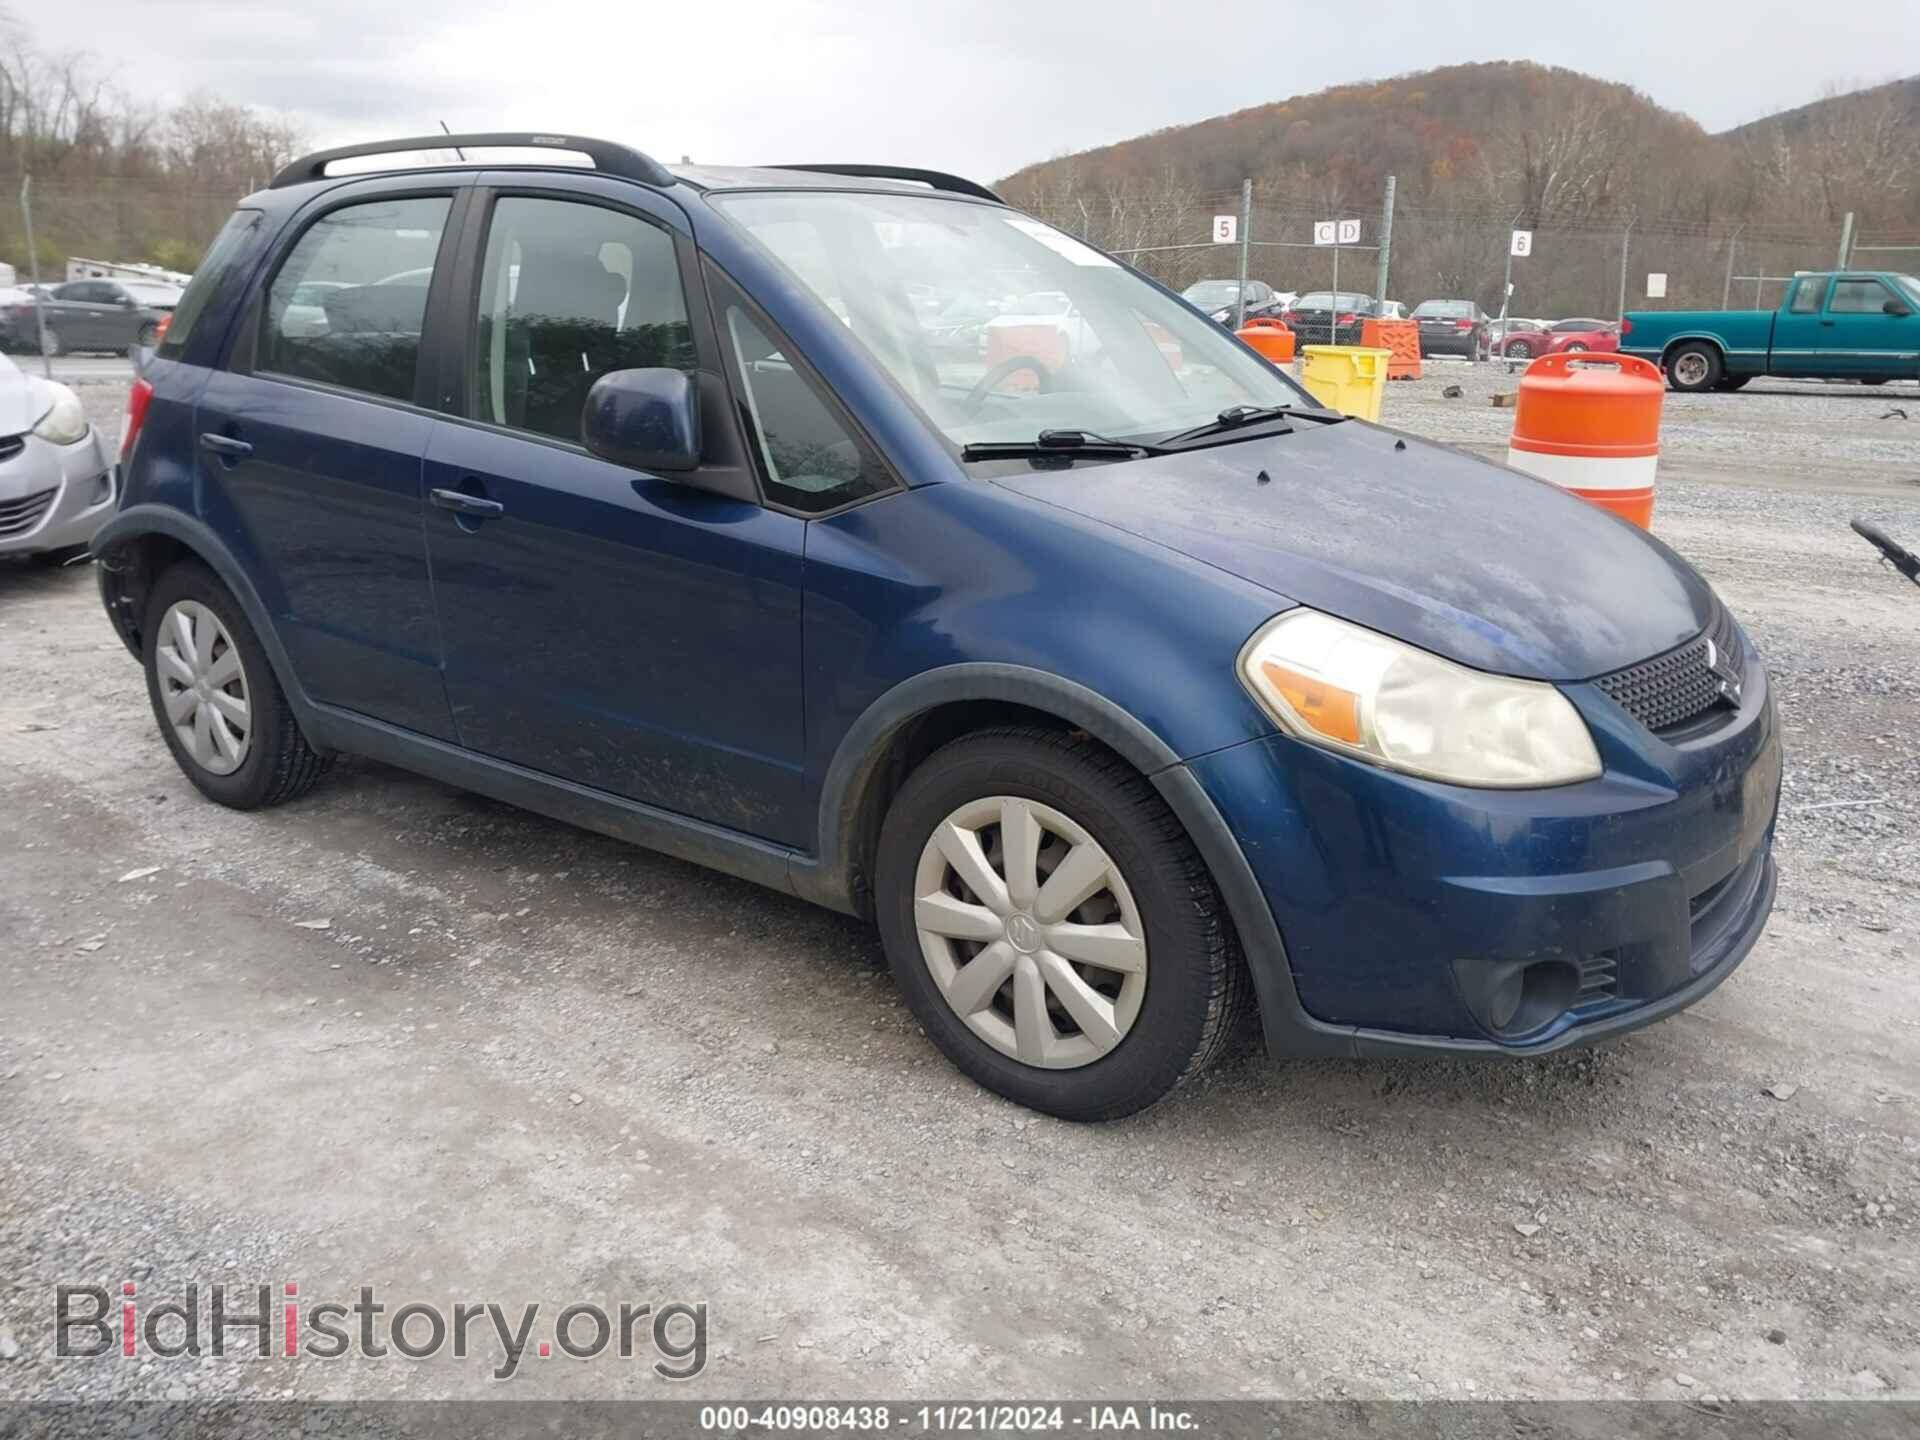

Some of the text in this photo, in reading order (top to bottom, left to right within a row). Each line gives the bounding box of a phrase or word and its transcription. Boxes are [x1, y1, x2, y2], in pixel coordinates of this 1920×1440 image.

[1219, 220, 1230, 238] 5
[1319, 225, 1331, 241] C
[1343, 224, 1356, 240] D
[1517, 235, 1526, 251] 6
